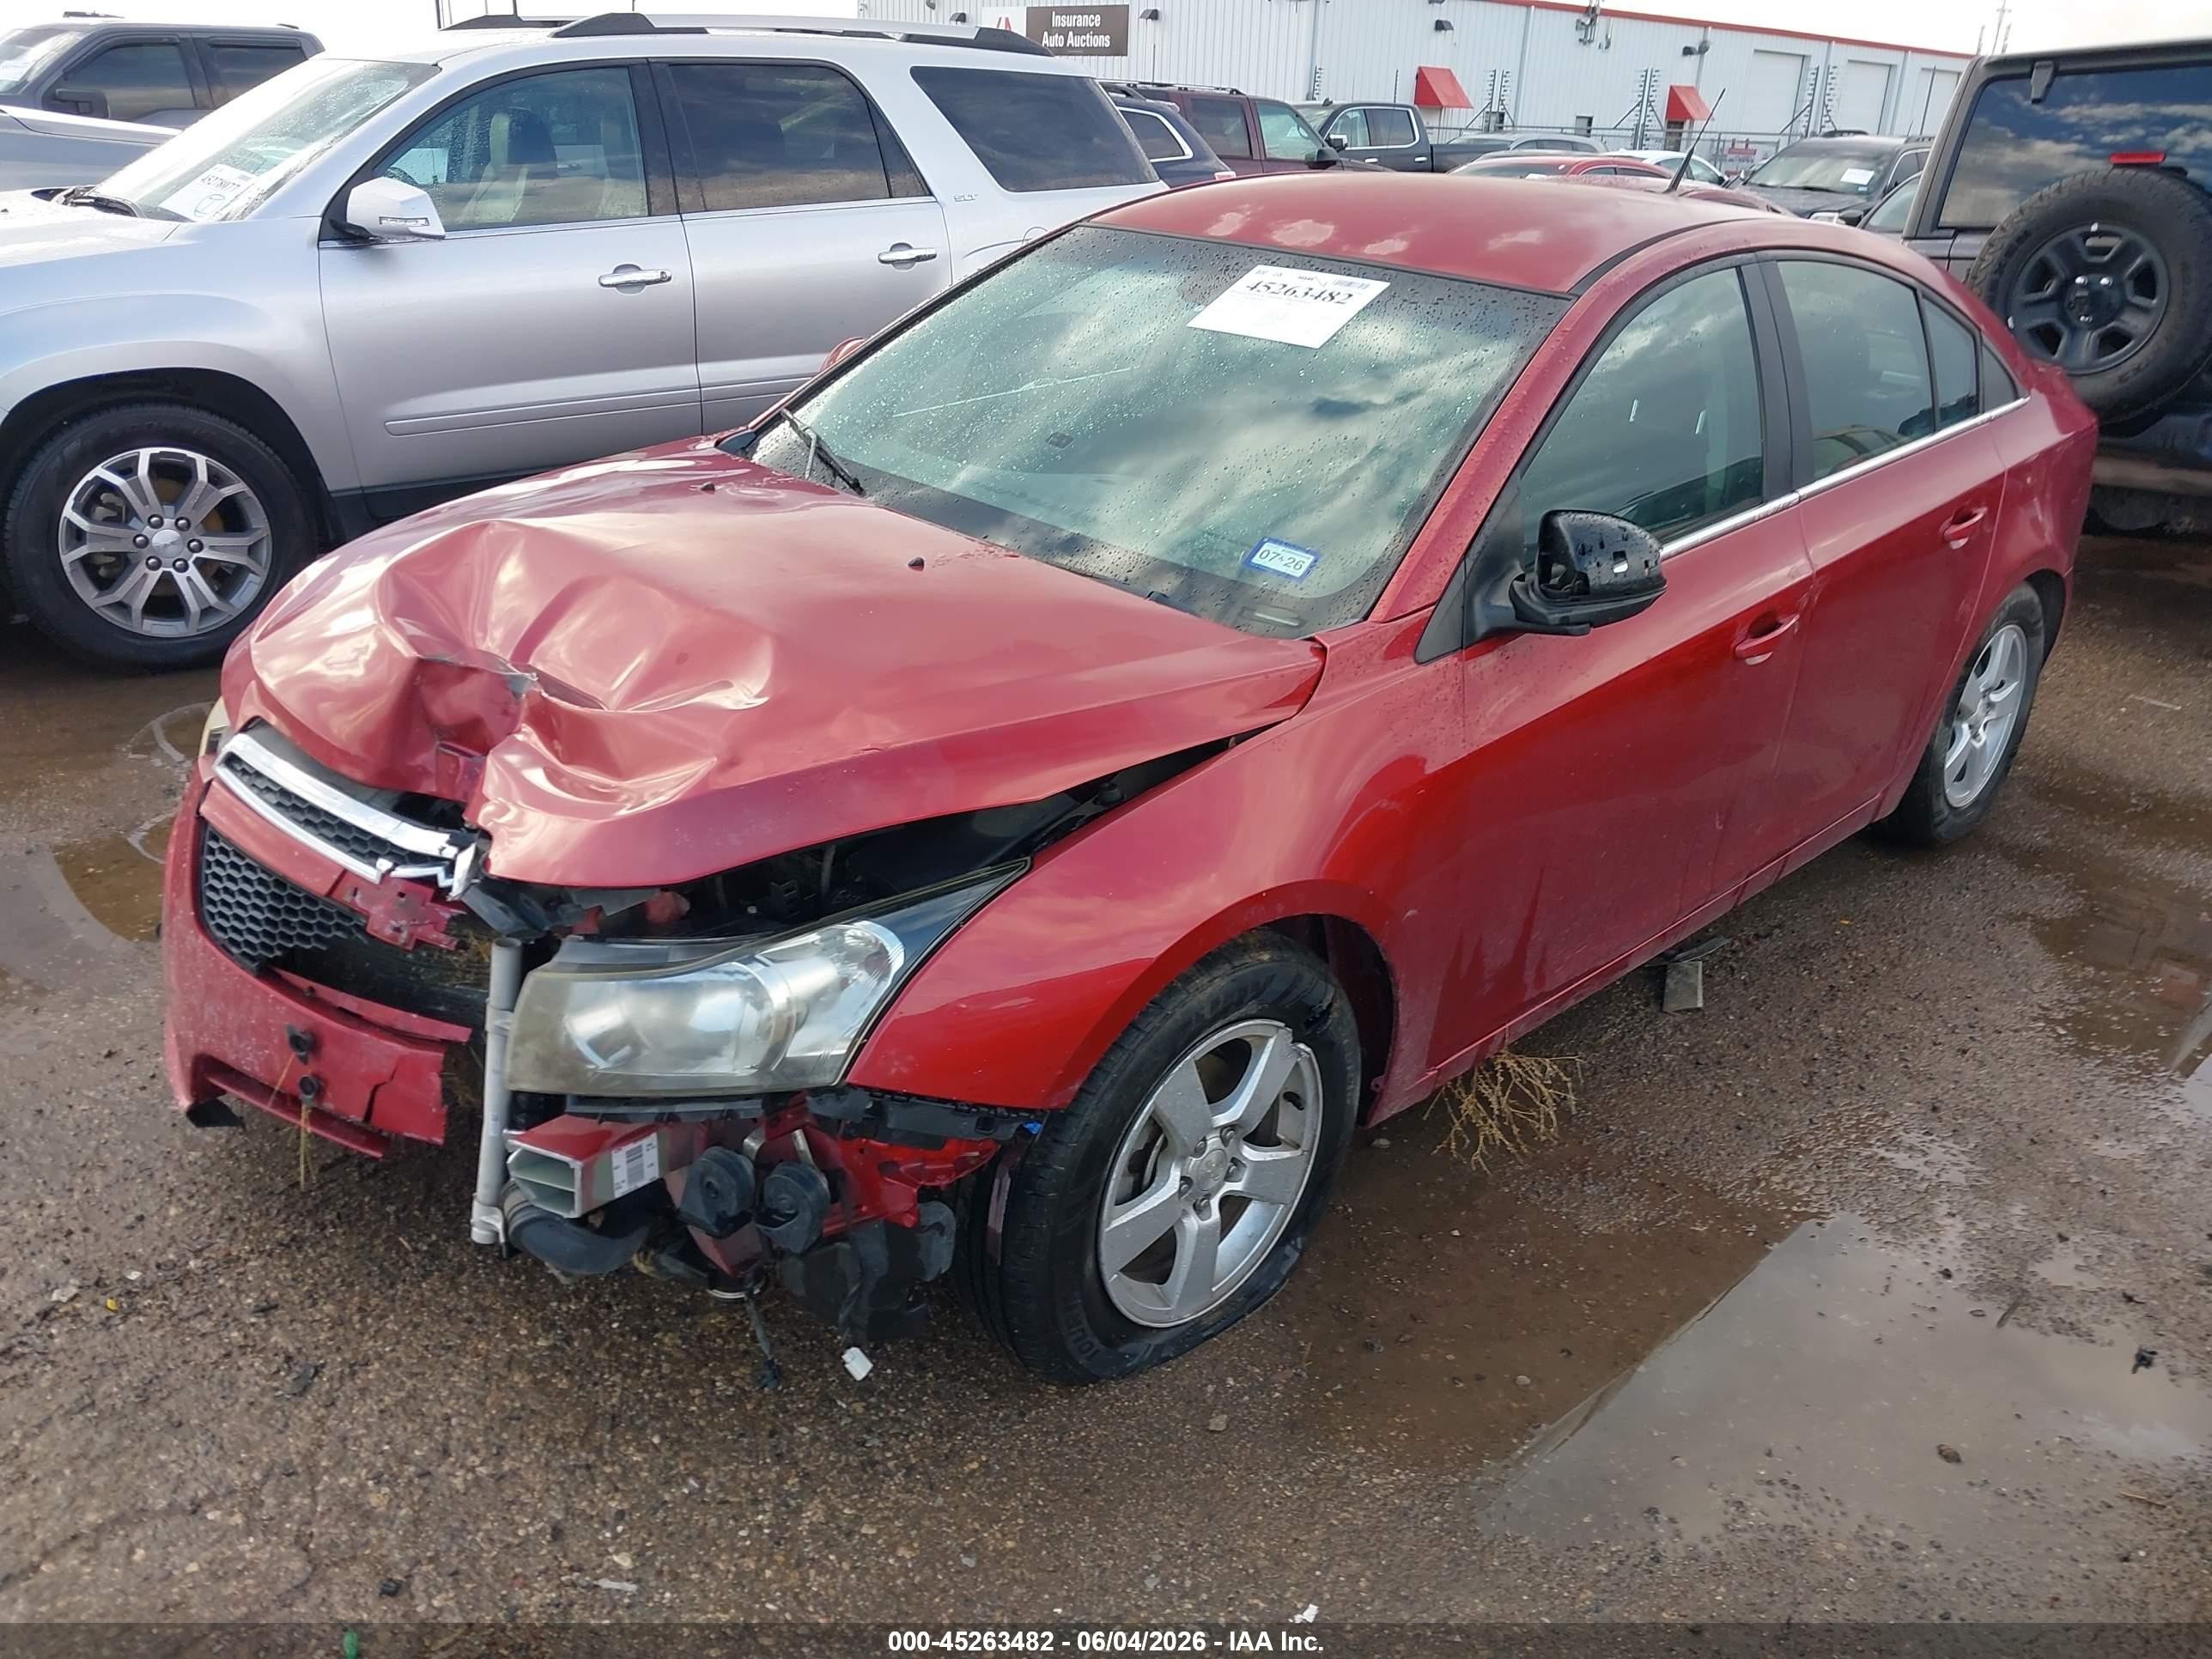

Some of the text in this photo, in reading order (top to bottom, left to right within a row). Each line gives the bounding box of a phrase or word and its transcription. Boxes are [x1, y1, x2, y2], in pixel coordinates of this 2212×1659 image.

[1052, 10, 1102, 27] Insurance
[1042, 31, 1110, 48] Auto Auctions
[1246, 281, 1353, 304] 45263482
